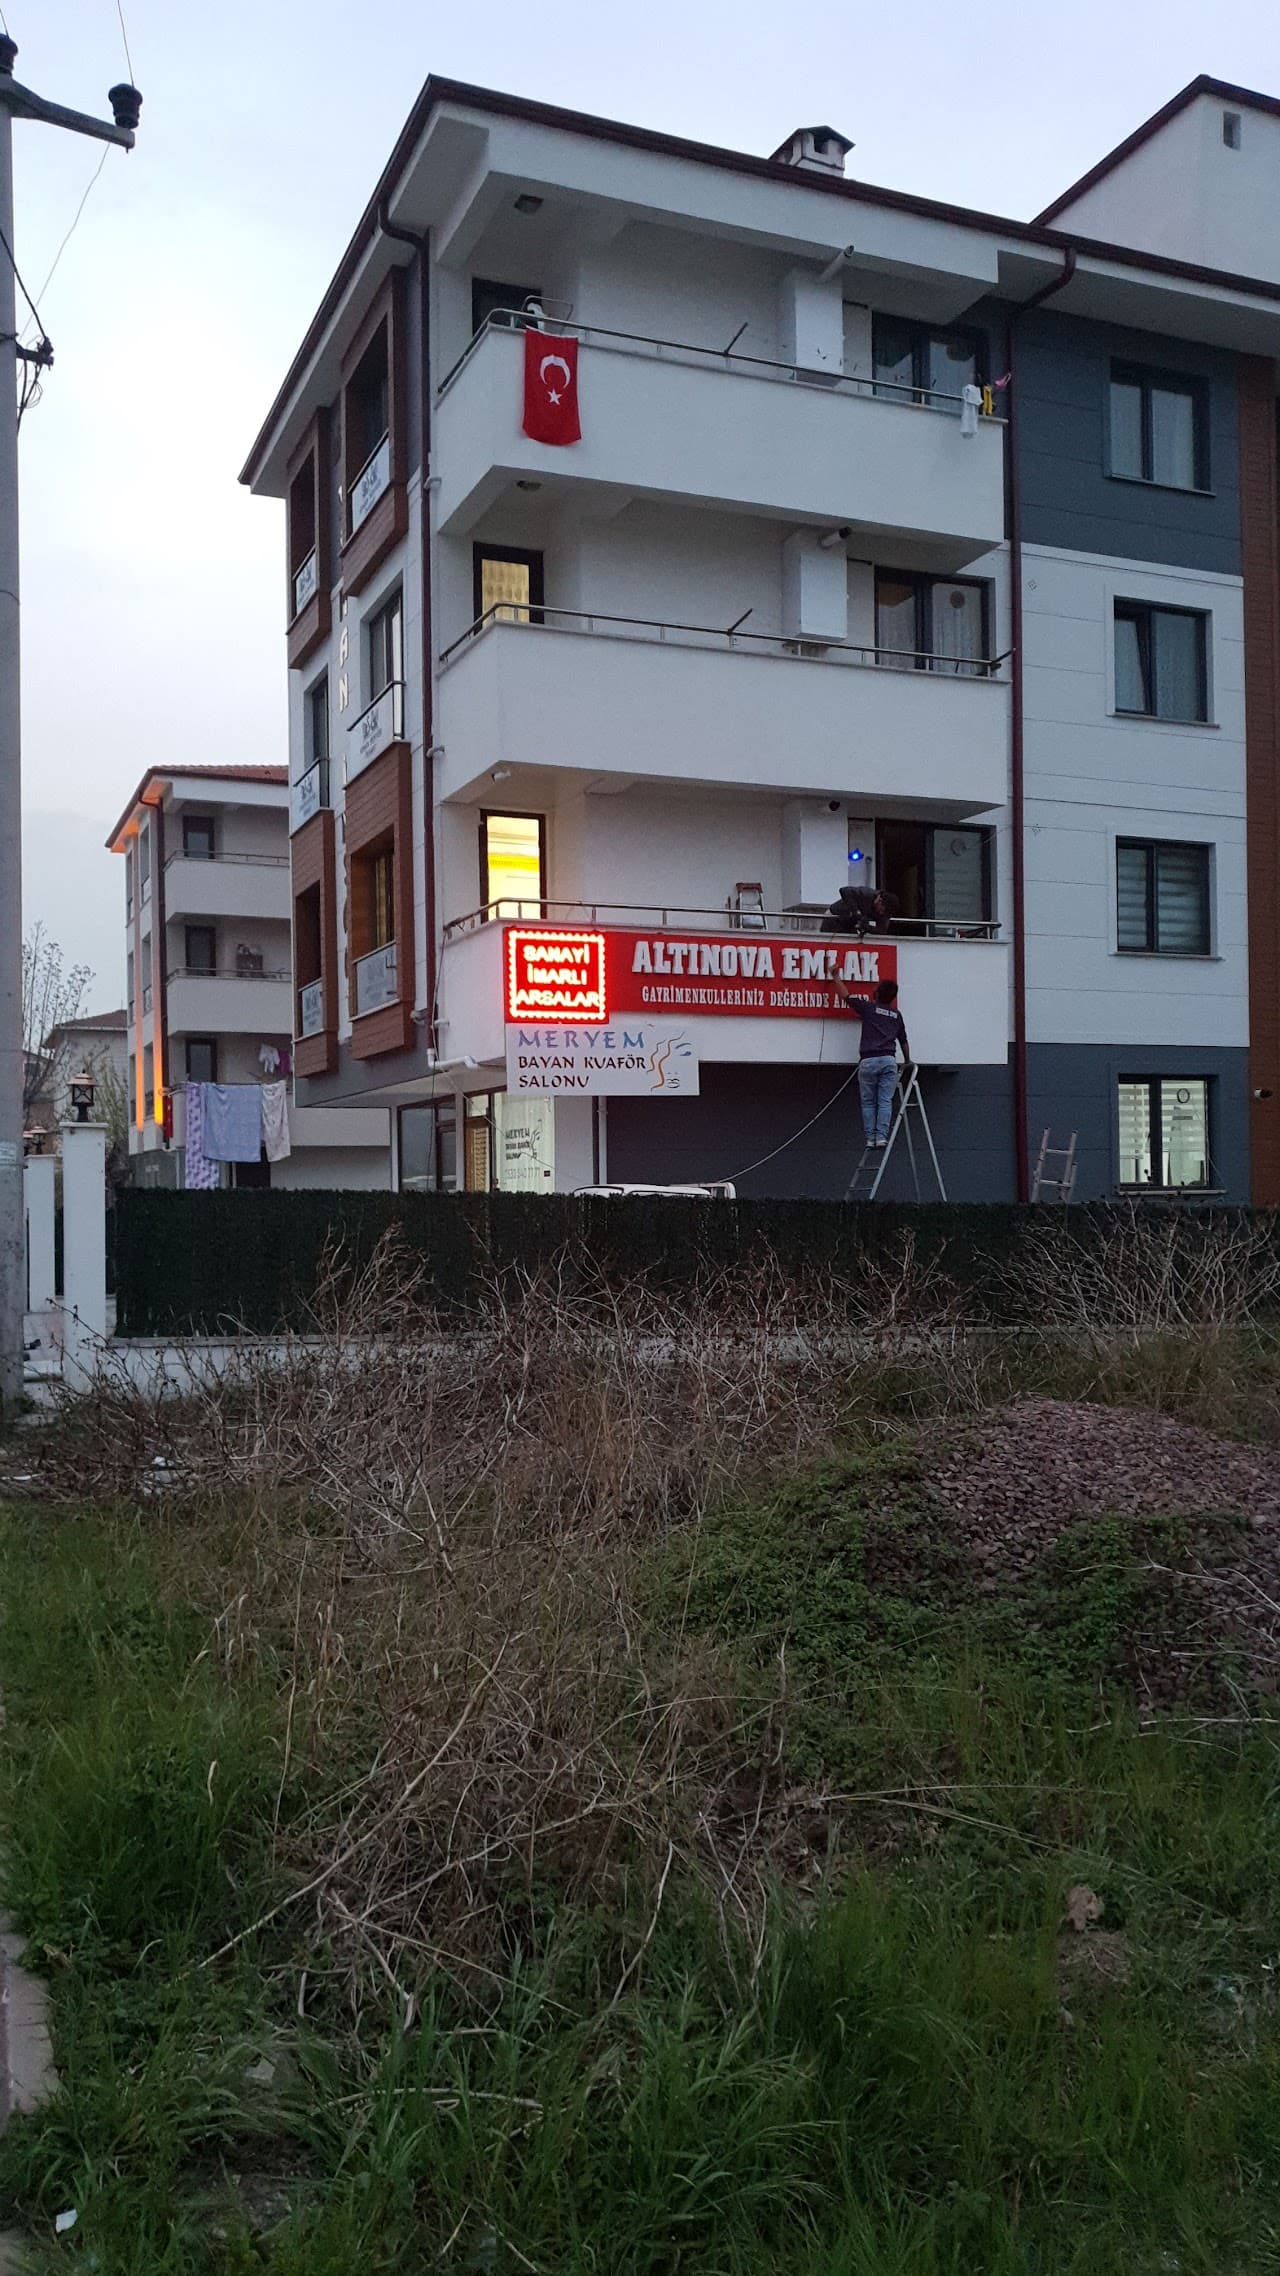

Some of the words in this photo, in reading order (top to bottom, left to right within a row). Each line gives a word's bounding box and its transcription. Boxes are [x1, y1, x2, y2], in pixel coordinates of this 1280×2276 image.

[523, 944, 590, 964] SANAYİ
[632, 941, 775, 978] ALTINOVA
[781, 947, 879, 982] EMLAK
[527, 962, 587, 985] İMARLI
[516, 989, 600, 1008] ARSALAR
[769, 988, 830, 1008] DEĞERİNDE
[518, 1029, 645, 1049] MERYEM
[518, 1056, 575, 1069] BAYAN
[584, 1054, 646, 1069] KUAFÖR
[518, 1075, 590, 1088] SALONU
